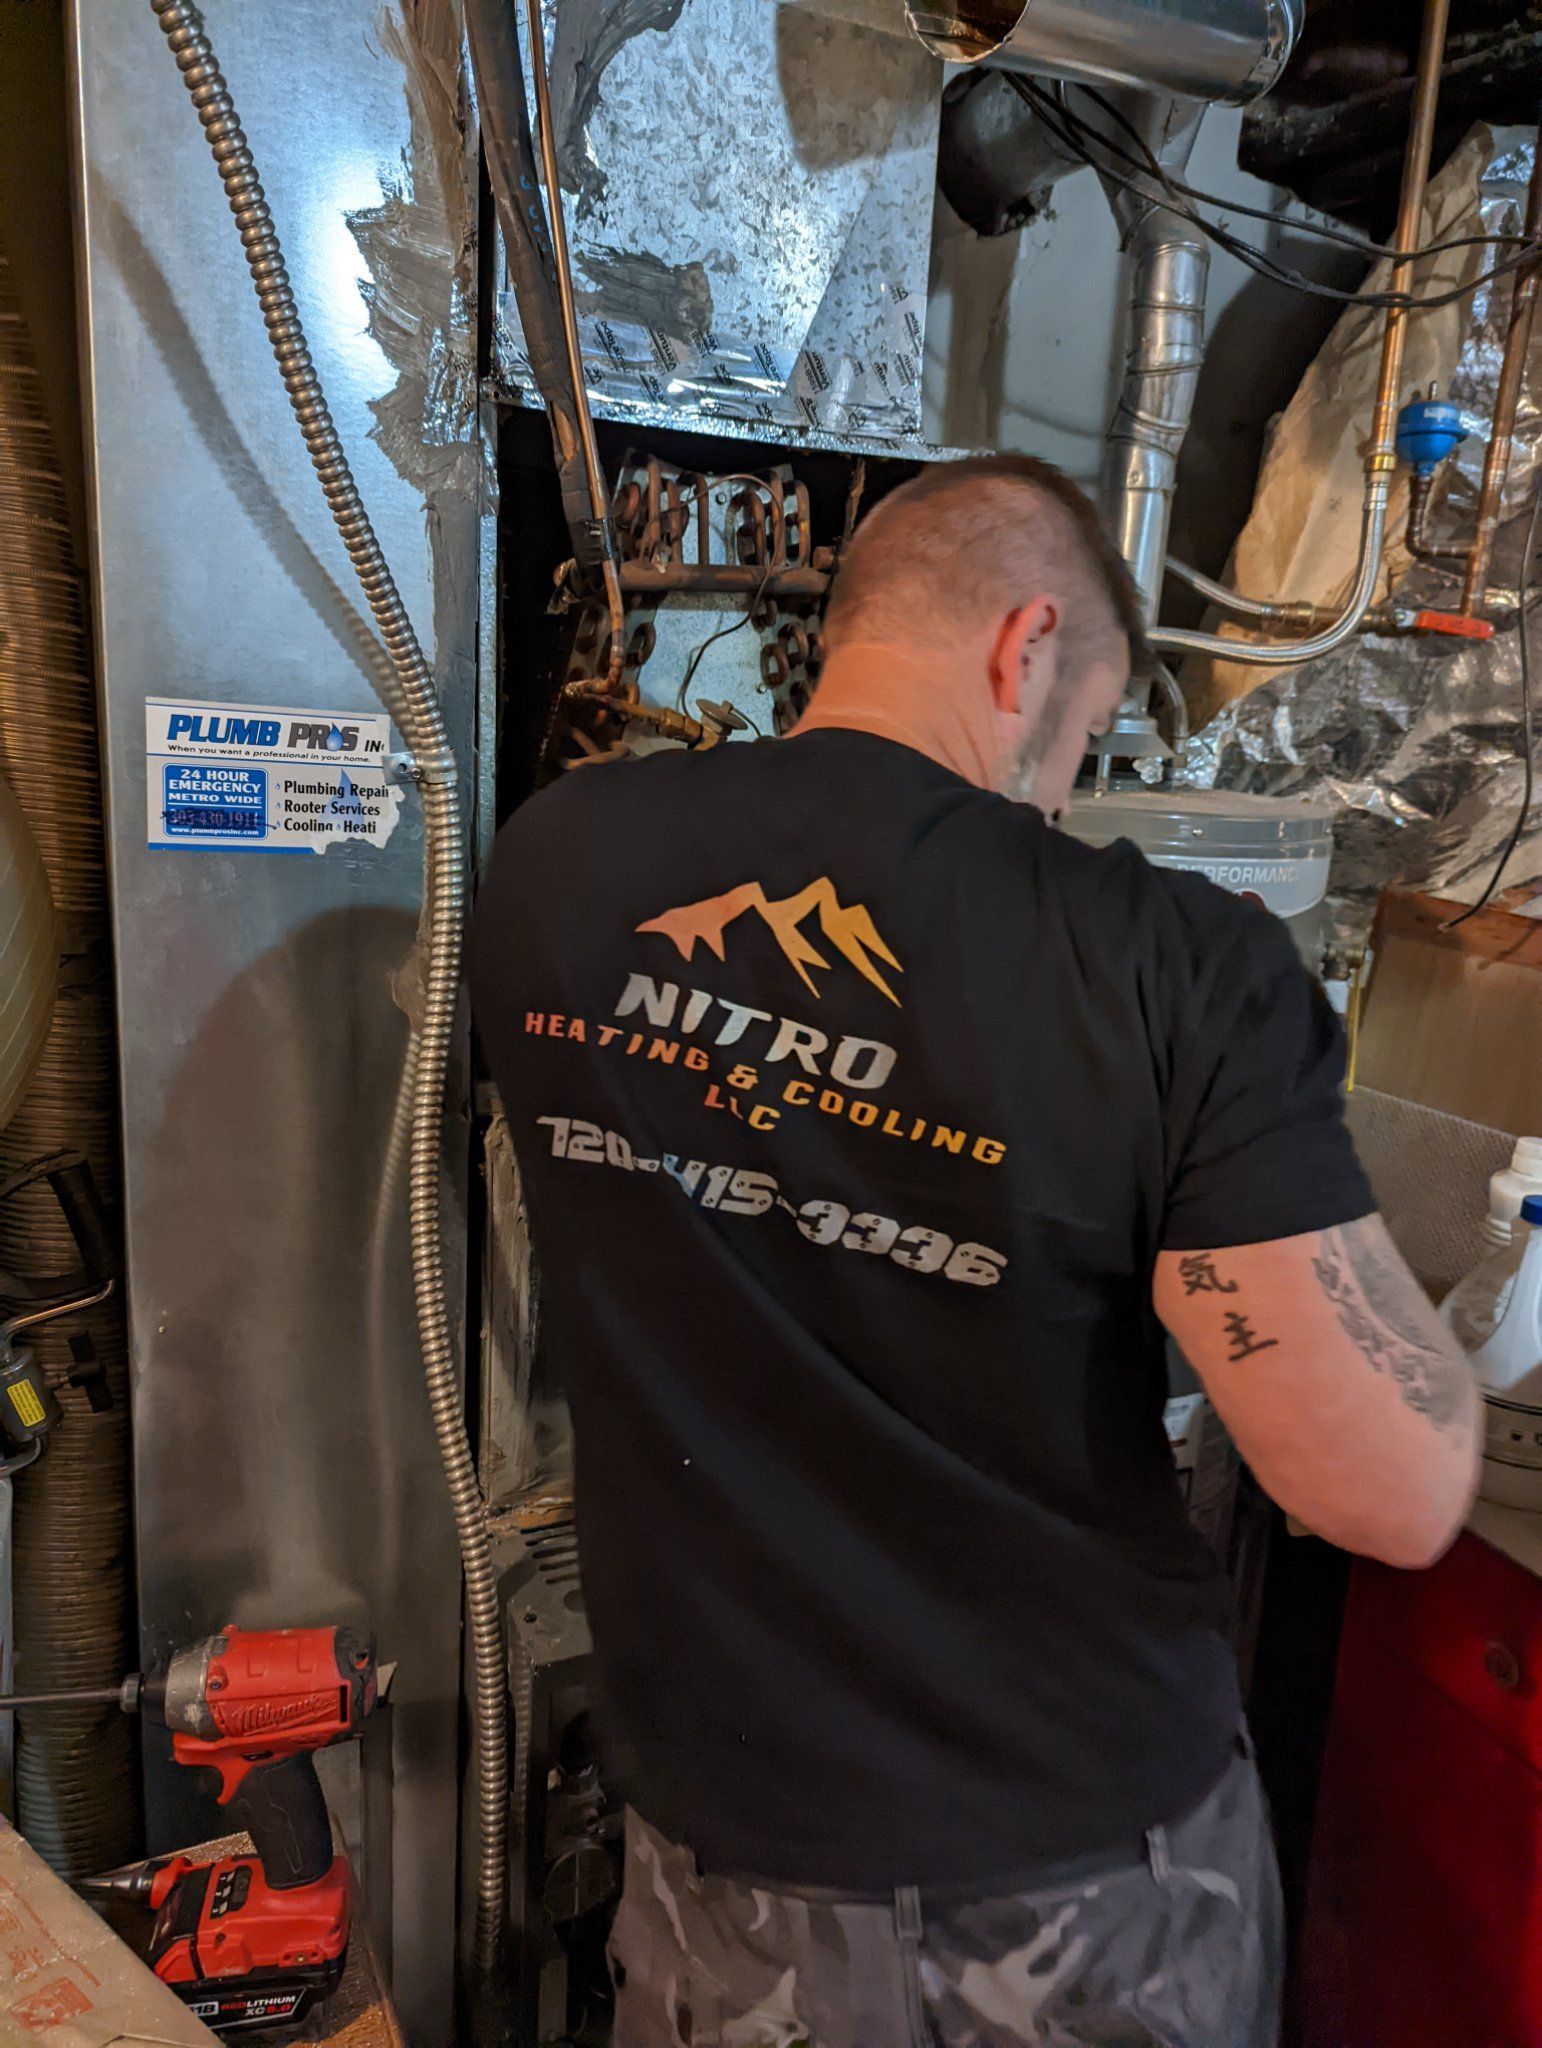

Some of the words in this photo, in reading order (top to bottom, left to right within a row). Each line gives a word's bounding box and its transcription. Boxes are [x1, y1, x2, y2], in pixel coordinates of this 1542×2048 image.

[167, 714, 281, 747] PLUMB
[168, 744, 196, 753] When
[219, 748, 242, 756] want
[253, 751, 308, 759] professional
[311, 751, 319, 759] in
[343, 755, 371, 763] home.
[181, 769, 201, 780] 24
[206, 770, 249, 782] HOUR
[169, 779, 262, 794] EMERGENCY
[284, 780, 345, 799] Plumbing
[168, 792, 219, 802] METRO
[224, 795, 262, 804] WIDE
[284, 799, 327, 814] Rooter
[331, 801, 380, 816] Services
[171, 827, 259, 836] www.plumbprosinc.com
[343, 820, 376, 834] Heati
[614, 972, 898, 1090] NITRO
[525, 1012, 710, 1071] HEATING
[726, 1063, 758, 1090] &
[782, 1080, 1007, 1165] COOLING
[536, 1115, 1008, 1286] 720-415-3336
